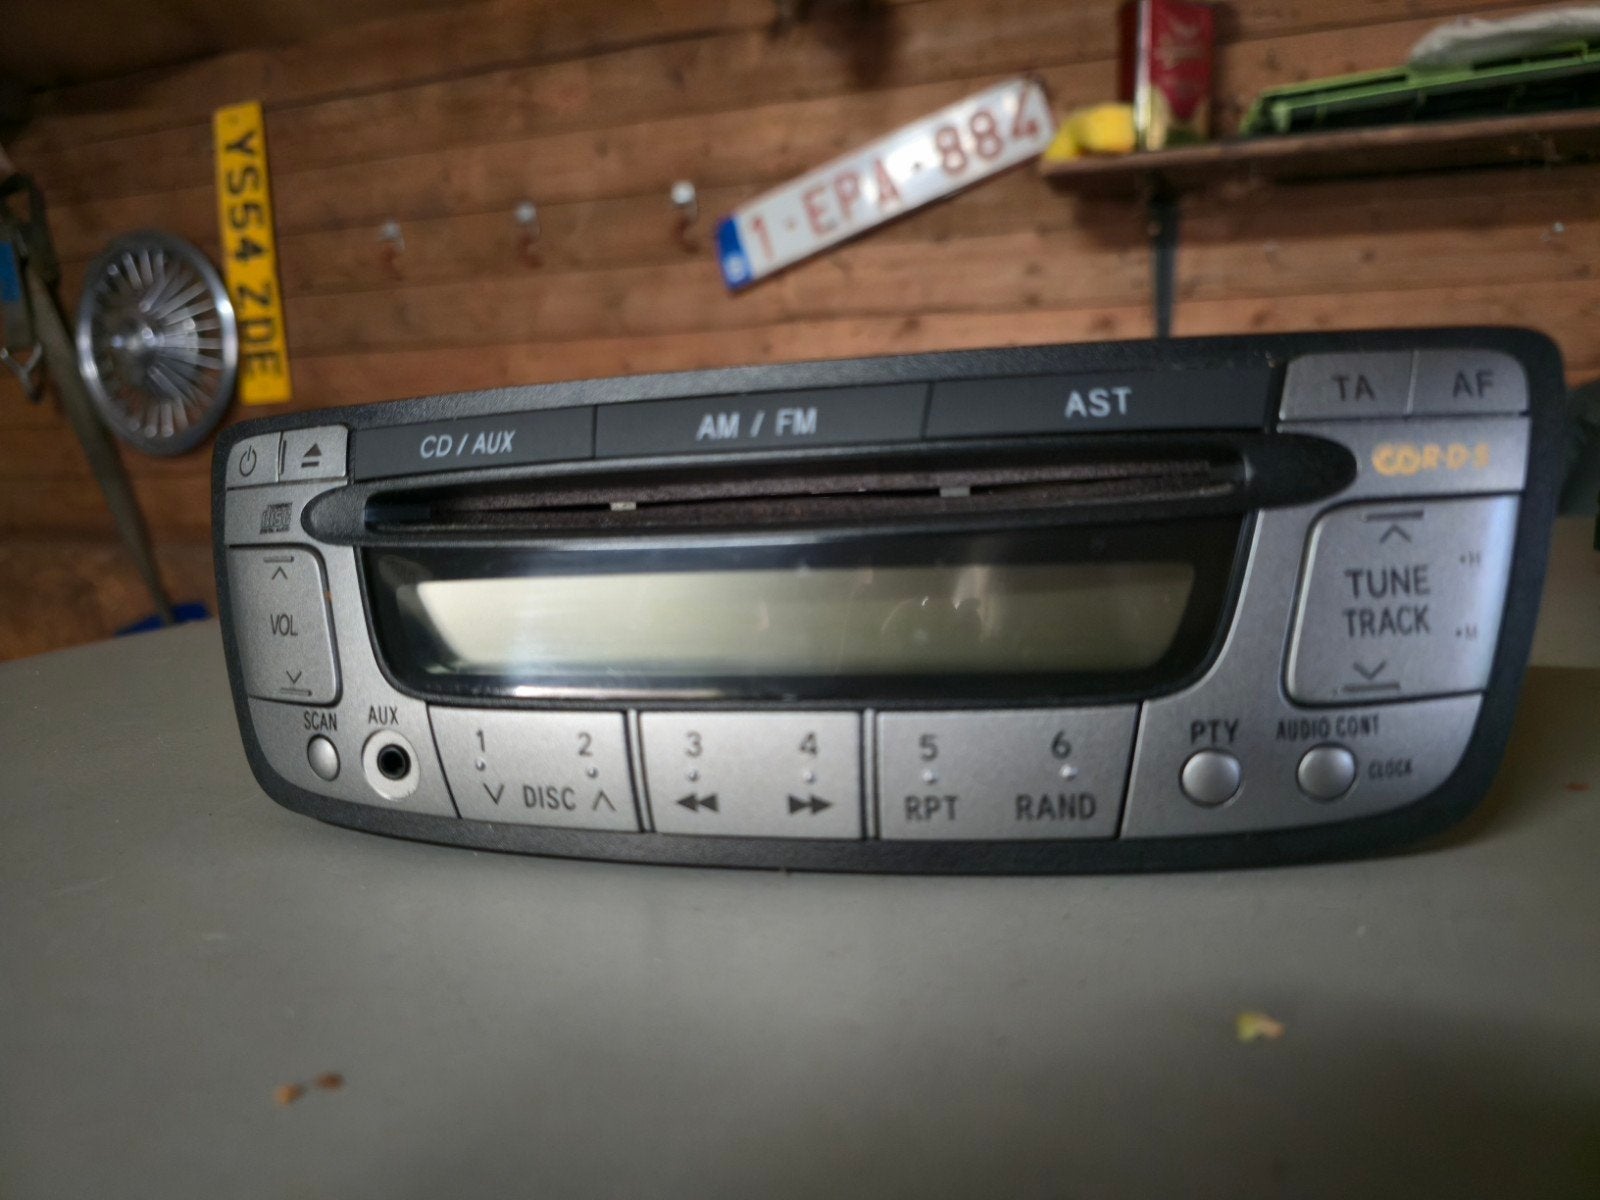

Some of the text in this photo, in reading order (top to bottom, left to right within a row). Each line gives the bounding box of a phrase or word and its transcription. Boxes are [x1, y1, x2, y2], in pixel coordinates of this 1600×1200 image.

[224, 130, 282, 374] YS54 ZDE
[1332, 375, 1376, 402] TA
[1452, 370, 1496, 398] AF
[1064, 387, 1132, 418] AST
[697, 413, 740, 440] AM
[775, 408, 819, 436] FM
[420, 434, 453, 458] CD
[472, 430, 516, 454] AUX
[1345, 565, 1431, 598] TUNE
[270, 614, 298, 637] VOL
[1343, 606, 1431, 639] TRACK
[304, 712, 338, 731] SCAN
[368, 705, 399, 725] AUX
[1276, 713, 1380, 741] AUDIO CONT
[475, 730, 485, 752] 1
[578, 733, 593, 756] 2
[685, 732, 703, 758] 3
[798, 732, 818, 757] 4
[1051, 730, 1073, 759] 6
[1190, 718, 1240, 745] PTY
[918, 734, 939, 760] 5
[1368, 758, 1413, 779] CLOCK
[523, 786, 577, 811] DISC
[905, 795, 958, 821] RPT
[1016, 793, 1097, 822] RAND
